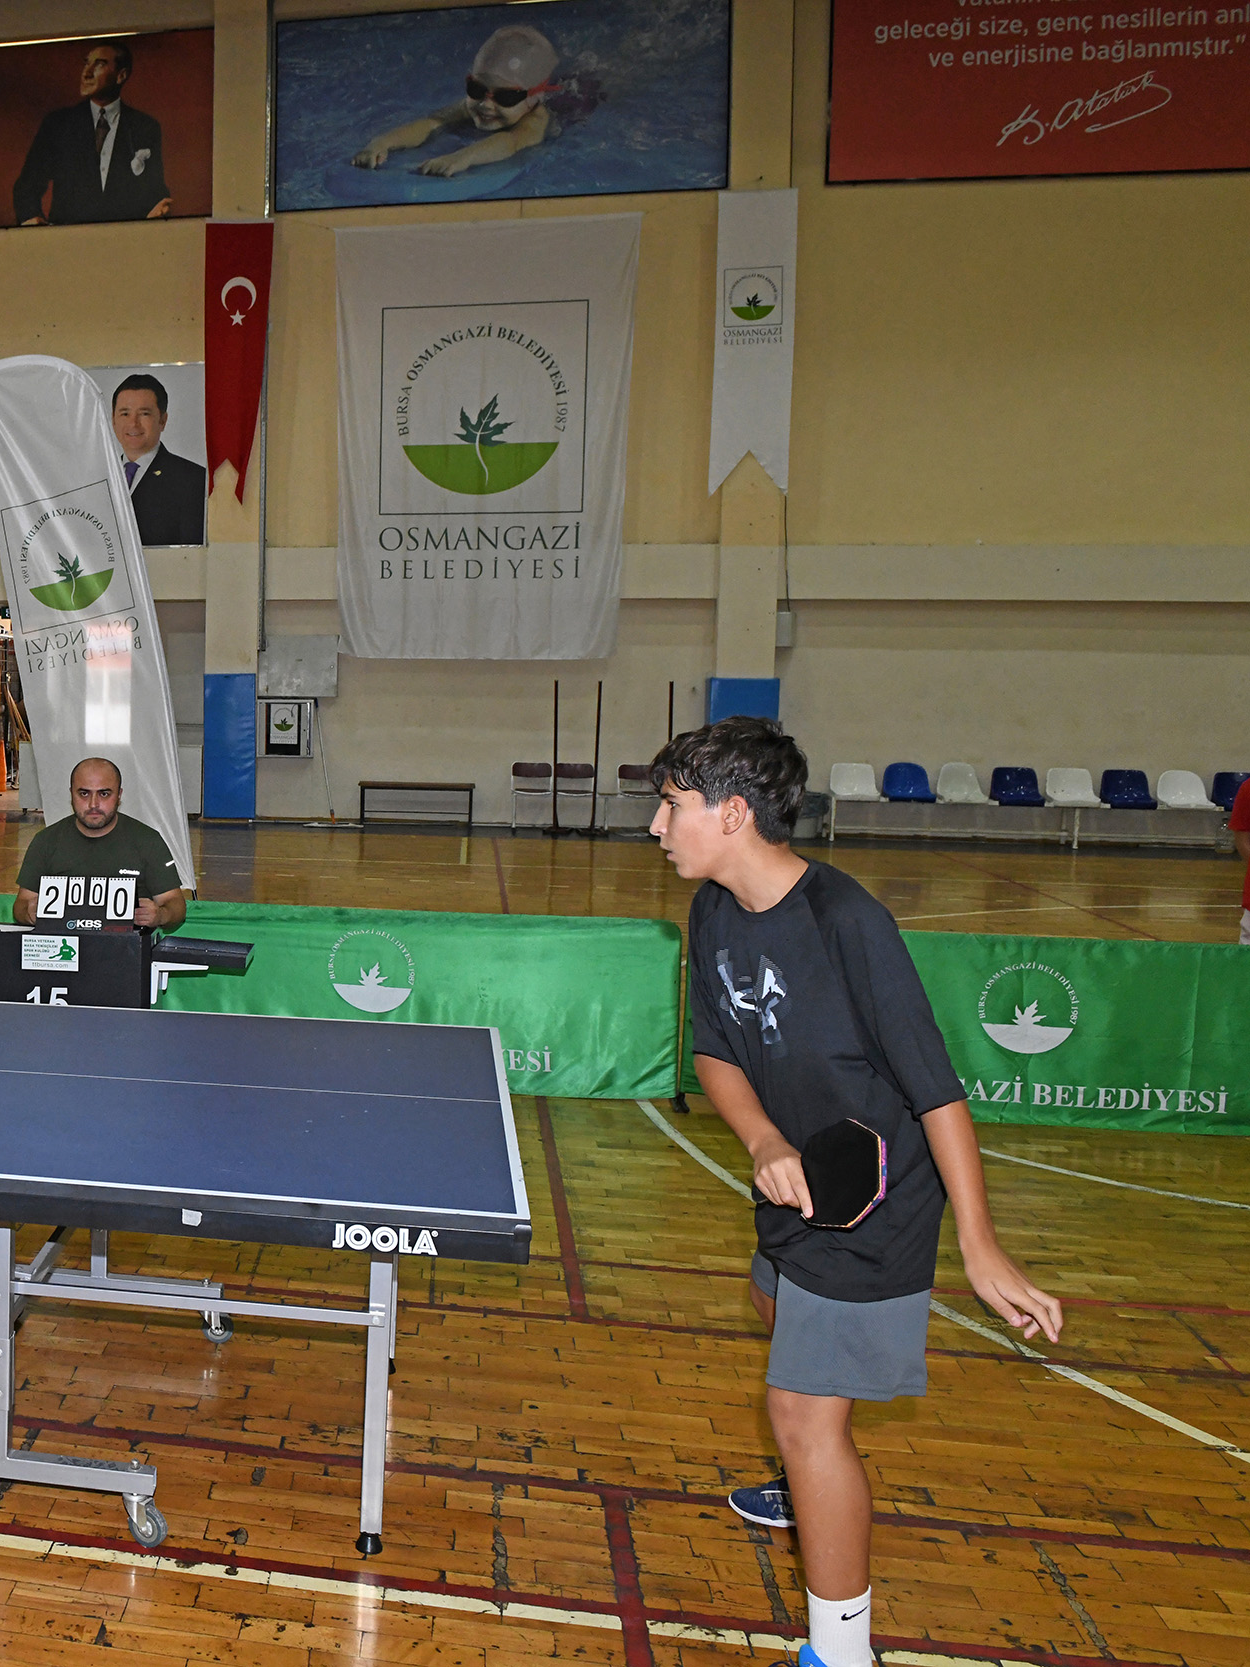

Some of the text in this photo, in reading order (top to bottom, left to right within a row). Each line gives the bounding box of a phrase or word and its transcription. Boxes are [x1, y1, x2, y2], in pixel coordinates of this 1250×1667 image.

[874, 16, 971, 43] geleceği
[979, 15, 1028, 37] size,
[1037, 14, 1093, 36] genç
[1102, 6, 1207, 29] nesillerin
[929, 52, 954, 67] ve
[962, 44, 1073, 67] enerjisine
[397, 322, 570, 436] BURSA OSMANGAZİ BELEDİYESİ 1987
[378, 521, 581, 551] OSMANGAZİ
[380, 556, 581, 579] BELEDİYESİ
[43, 883, 128, 917] 2 0 0 0
[77, 920, 102, 928] KBS
[978, 961, 1080, 1025] BURSA OSMANGAZİ BELEDİYESİ 1987
[1032, 1083, 1229, 1114] BELEDİYESİ
[332, 1223, 438, 1255] JOOLA
